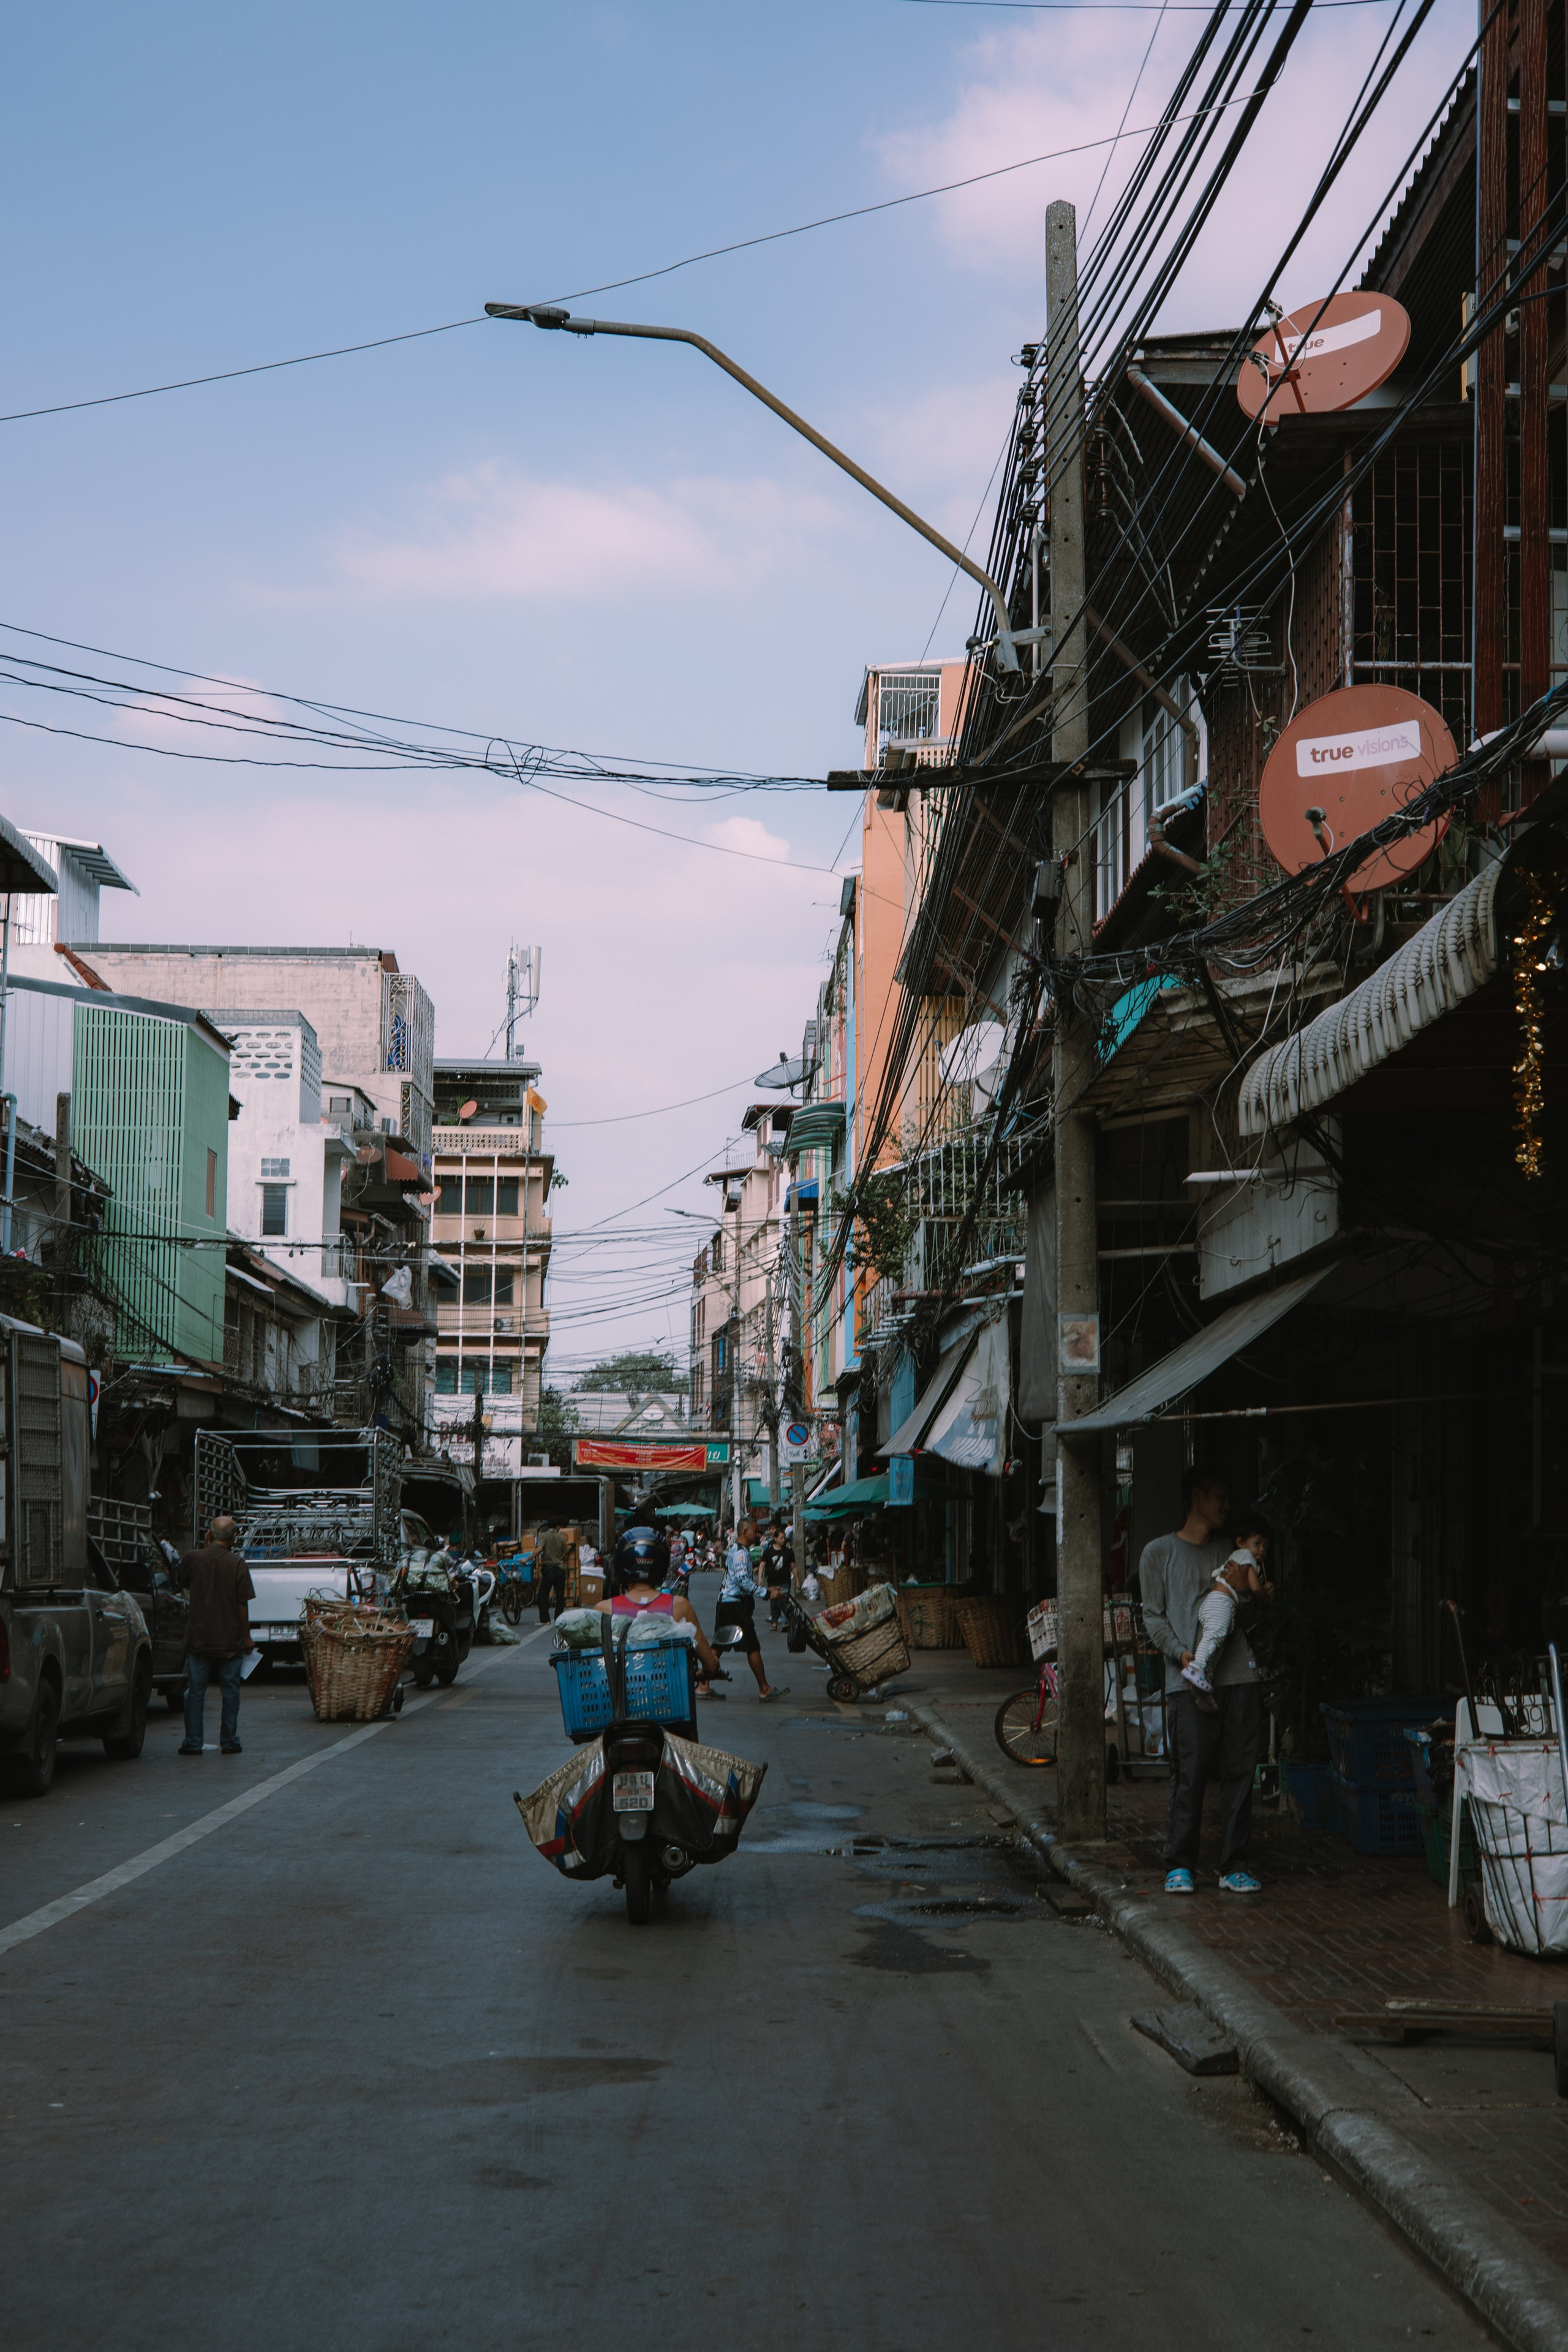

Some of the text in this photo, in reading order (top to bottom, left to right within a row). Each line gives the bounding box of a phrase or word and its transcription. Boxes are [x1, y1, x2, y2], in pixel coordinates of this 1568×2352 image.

[1287, 338, 1325, 353] tue
[1310, 736, 1409, 763] true visions
